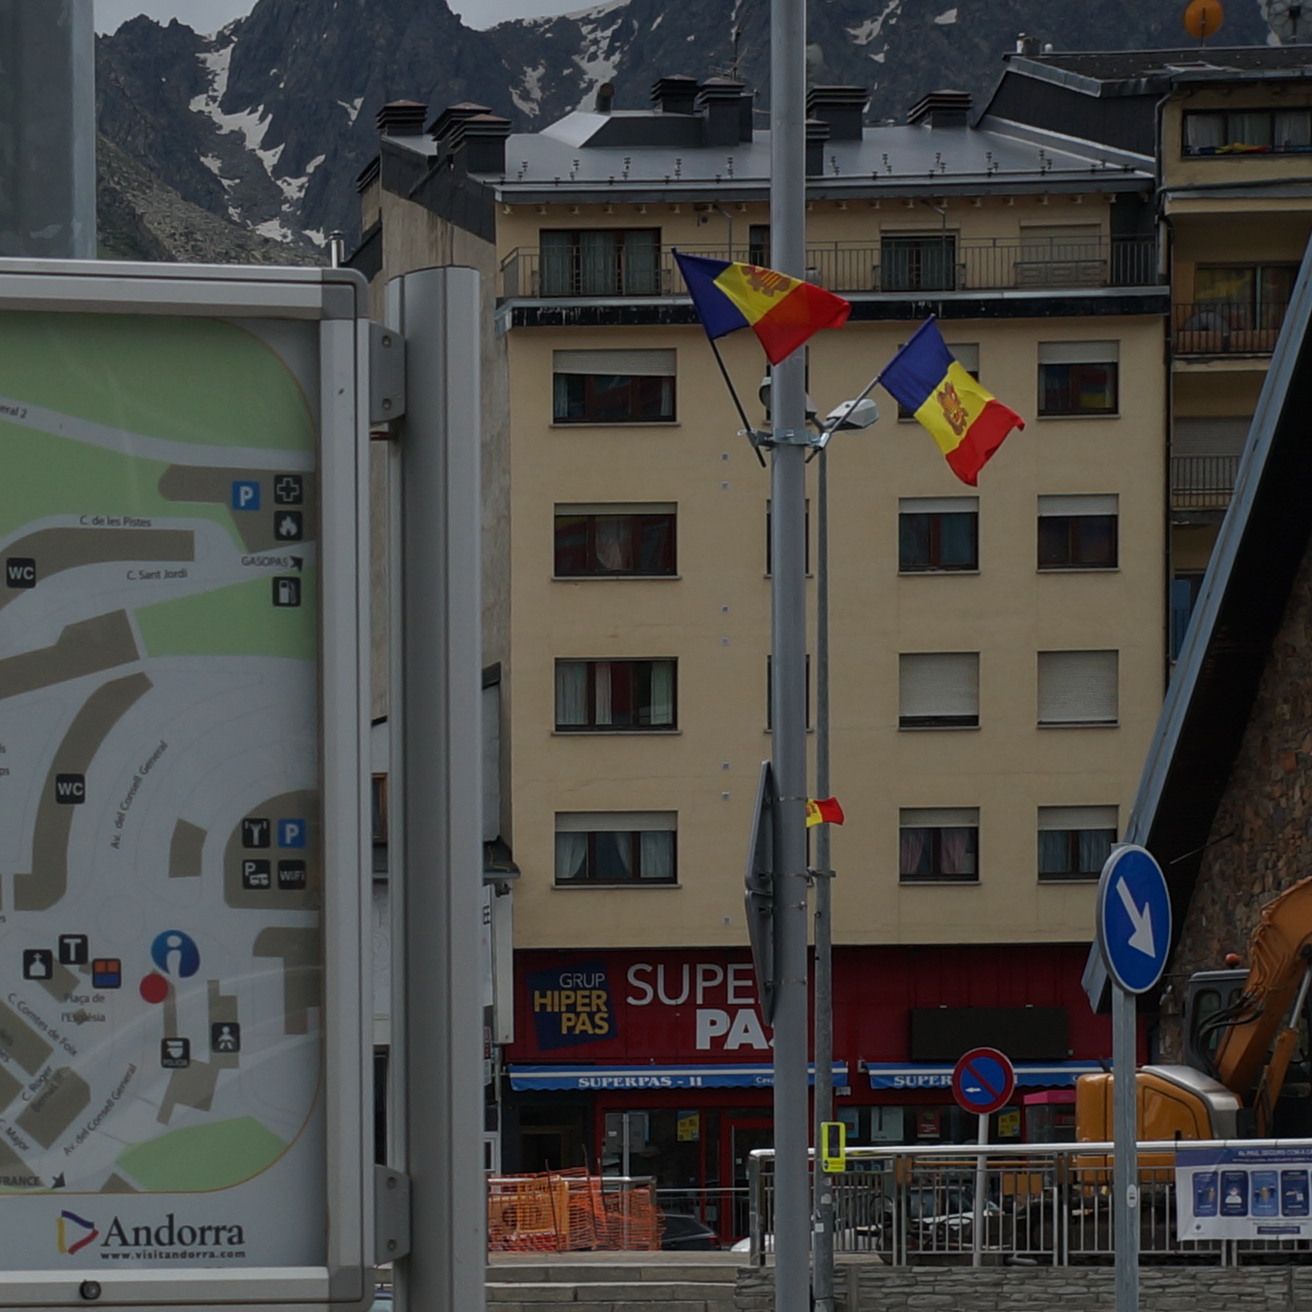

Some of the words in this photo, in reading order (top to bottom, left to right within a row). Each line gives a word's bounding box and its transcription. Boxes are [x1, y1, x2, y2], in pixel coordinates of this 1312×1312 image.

[20, 408, 27, 419] 2
[80, 515, 90, 526] C.
[92, 515, 104, 526] de
[107, 515, 120, 527] les
[123, 515, 151, 528] Pistes
[241, 556, 288, 567] GASOPAS
[9, 566, 34, 581] WC
[127, 569, 137, 581] C.
[139, 568, 161, 581] Sant
[164, 568, 187, 581] Jordi
[559, 973, 605, 989] GRUP
[626, 963, 760, 1006] SUPE
[534, 990, 608, 1012] HIPER
[561, 1012, 609, 1035] PAS
[696, 1008, 774, 1050] PA
[579, 1075, 672, 1088] SUPERPAS
[101, 1214, 245, 1247] Andorra
[101, 1250, 245, 1259] www.visitandorra.com
